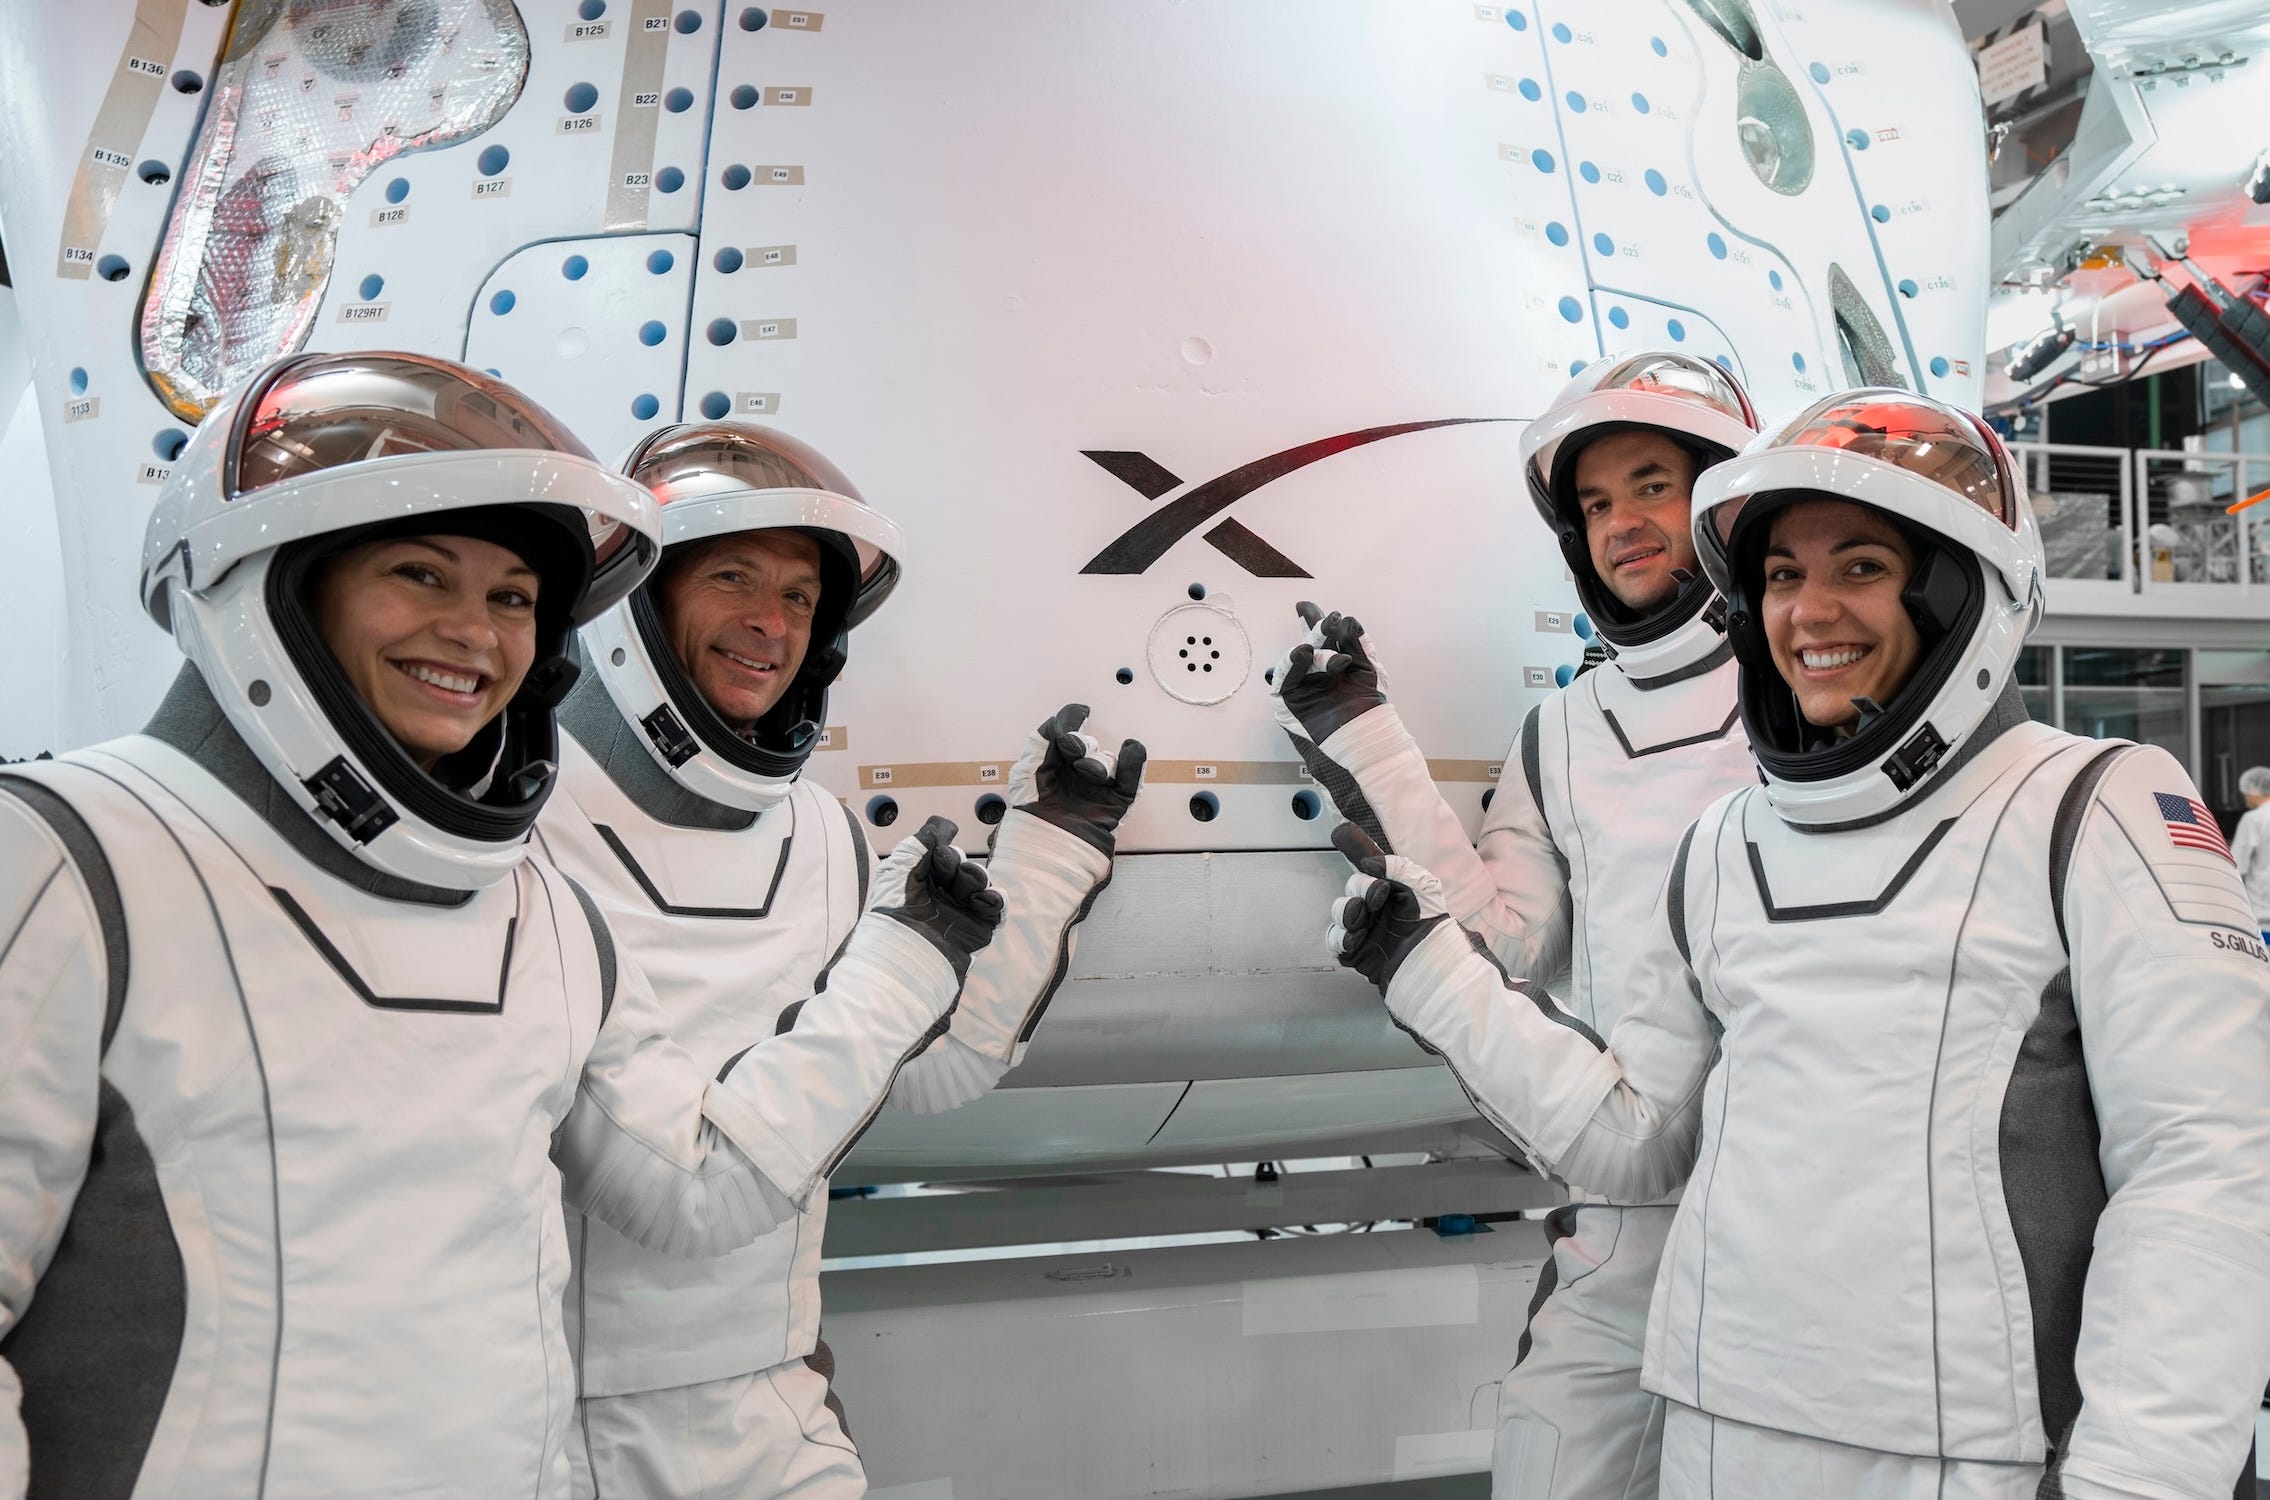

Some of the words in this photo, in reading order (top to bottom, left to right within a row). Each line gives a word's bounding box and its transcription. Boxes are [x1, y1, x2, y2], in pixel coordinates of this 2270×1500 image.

[646, 19, 667, 29] B21
[576, 25, 604, 36] B125
[130, 58, 164, 75] B136
[635, 94, 658, 104] B22
[564, 118, 593, 130] B126
[95, 149, 129, 167] B135
[626, 175, 649, 185] B23
[477, 181, 505, 194] B127
[378, 209, 404, 222] B128
[66, 248, 93, 261] B134
[345, 307, 384, 319] B129RT
[1548, 617, 1559, 625] E29
[1532, 673, 1544, 681] E30
[875, 771, 890, 780] E39
[982, 769, 996, 777] E38
[1197, 767, 1211, 775] E36
